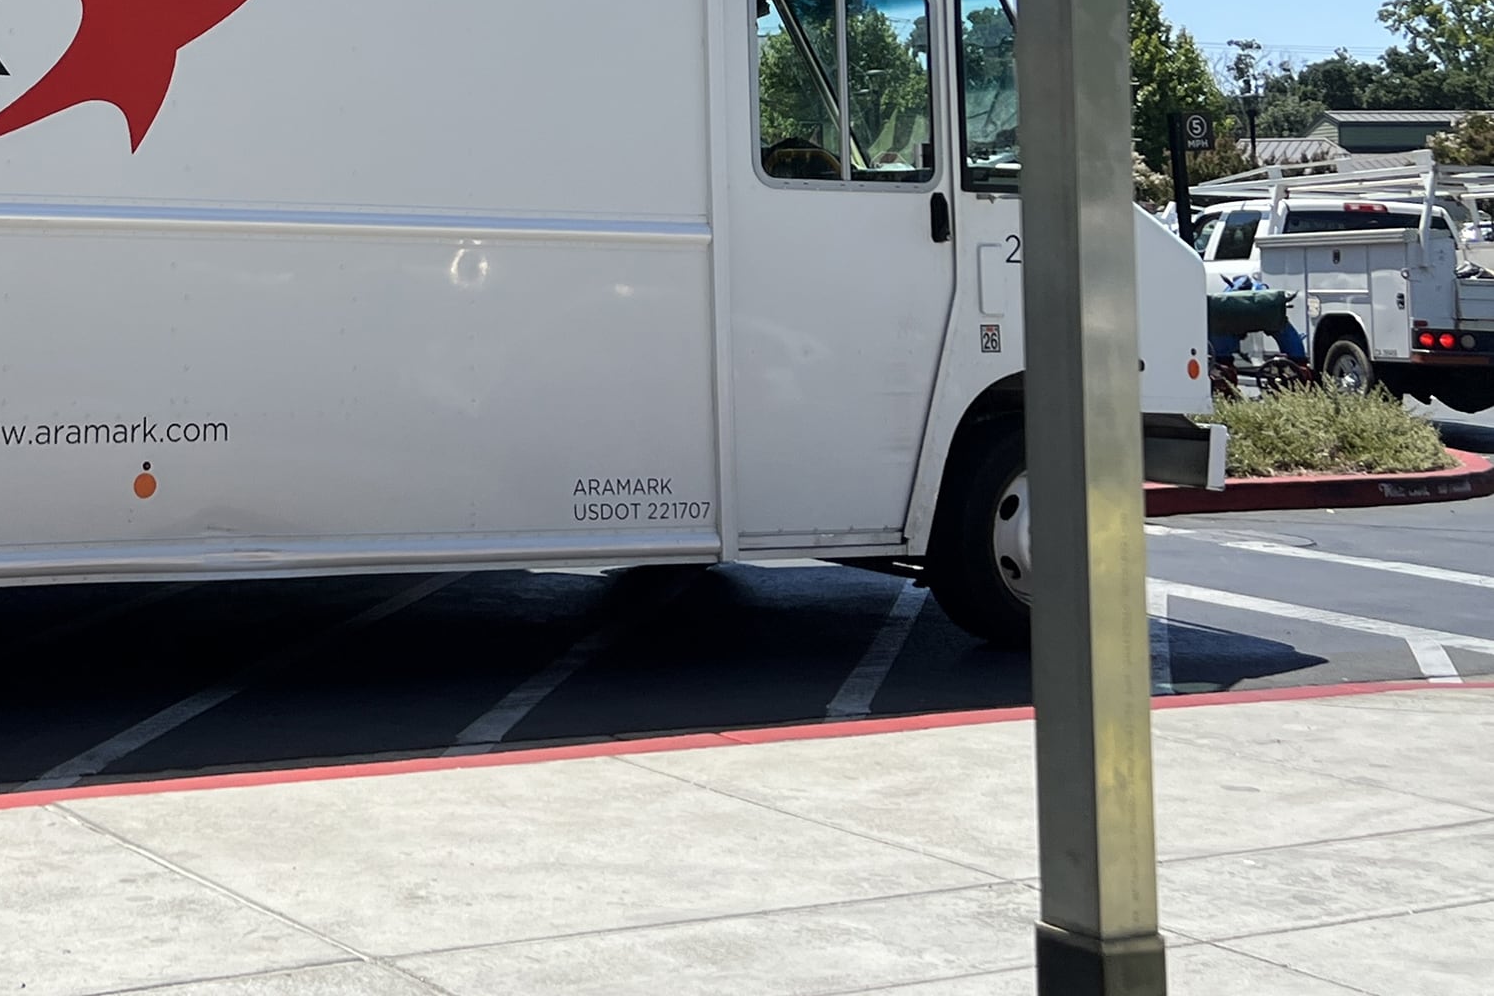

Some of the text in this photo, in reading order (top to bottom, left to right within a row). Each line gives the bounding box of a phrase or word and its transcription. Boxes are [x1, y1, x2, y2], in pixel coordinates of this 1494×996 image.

[1192, 120, 1202, 134] 5
[1187, 140, 1209, 148] MPH
[982, 332, 998, 350] 26
[573, 478, 673, 496] ARAMARK
[574, 501, 711, 521] USDOT 221707
